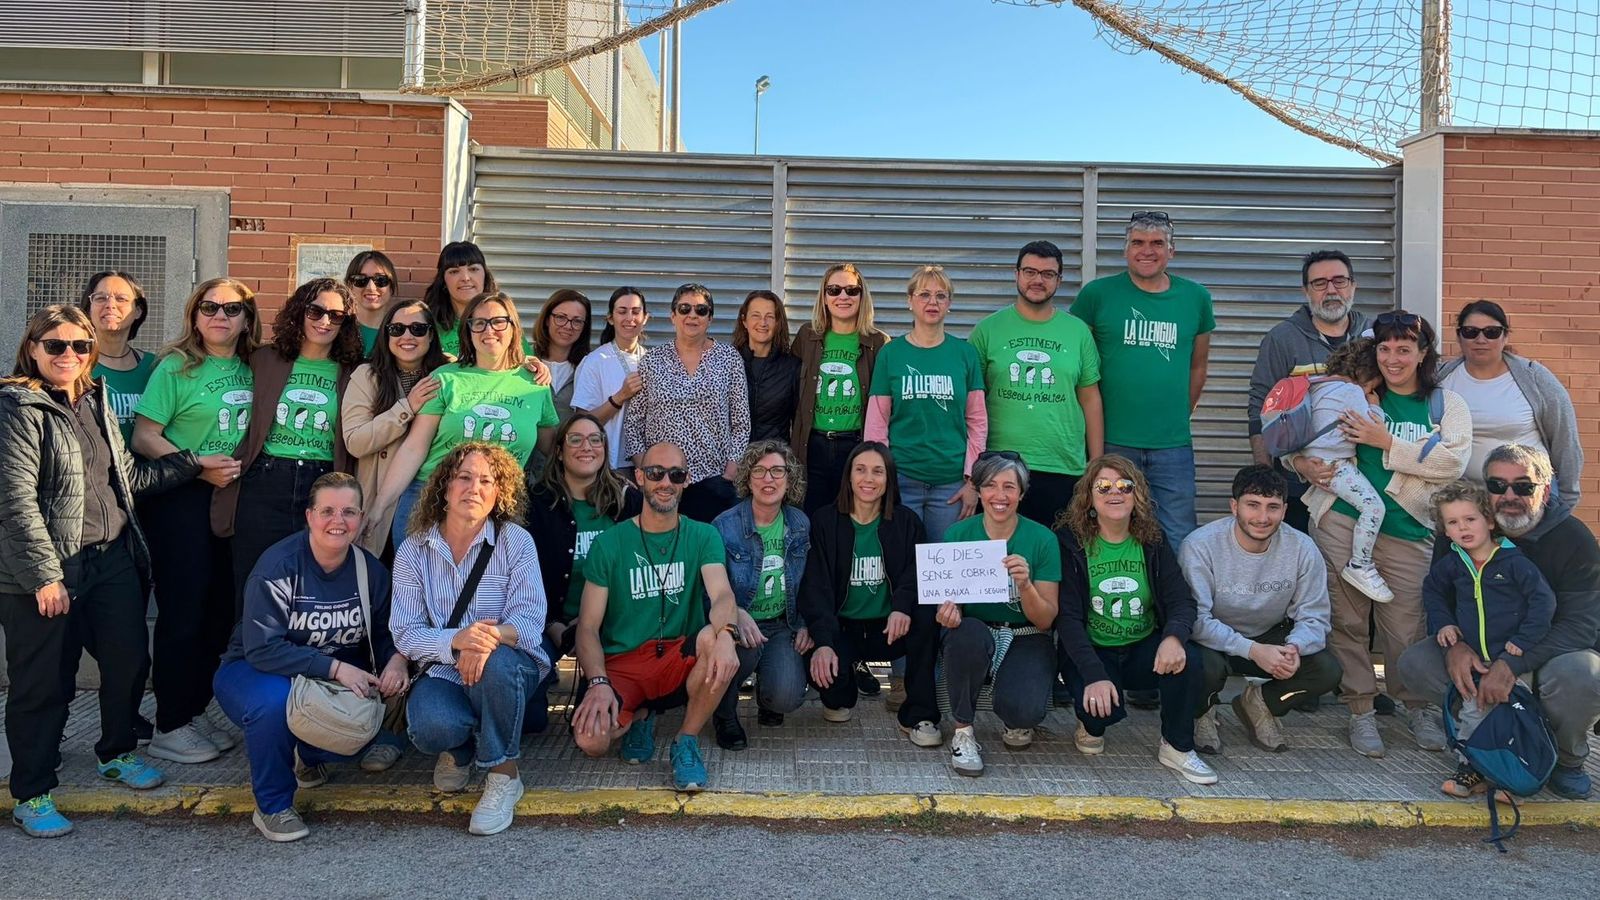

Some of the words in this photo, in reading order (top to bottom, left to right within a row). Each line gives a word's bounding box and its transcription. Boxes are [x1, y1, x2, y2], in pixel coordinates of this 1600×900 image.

[1124, 319, 1137, 341] LA
[1138, 319, 1178, 345] LLENGUA
[1008, 337, 1062, 353] ESTIMEM
[1153, 342, 1176, 350] TOCA
[822, 349, 860, 362] STIME
[204, 374, 254, 394] ESTIME
[287, 372, 338, 392] STIME
[902, 375, 914, 396] LA
[915, 374, 955, 396] LLENGUA
[460, 391, 524, 409] ESTIMEM
[1033, 391, 1067, 404] PÚBLICA
[927, 548, 946, 565] 46
[953, 548, 984, 562] DIES
[630, 567, 645, 595] LA
[643, 561, 685, 592] LLENGUA
[921, 569, 954, 582] SENSE
[960, 567, 999, 578] COBRIR
[631, 592, 646, 600] NO
[647, 590, 660, 598] ES
[922, 589, 940, 598] UNA
